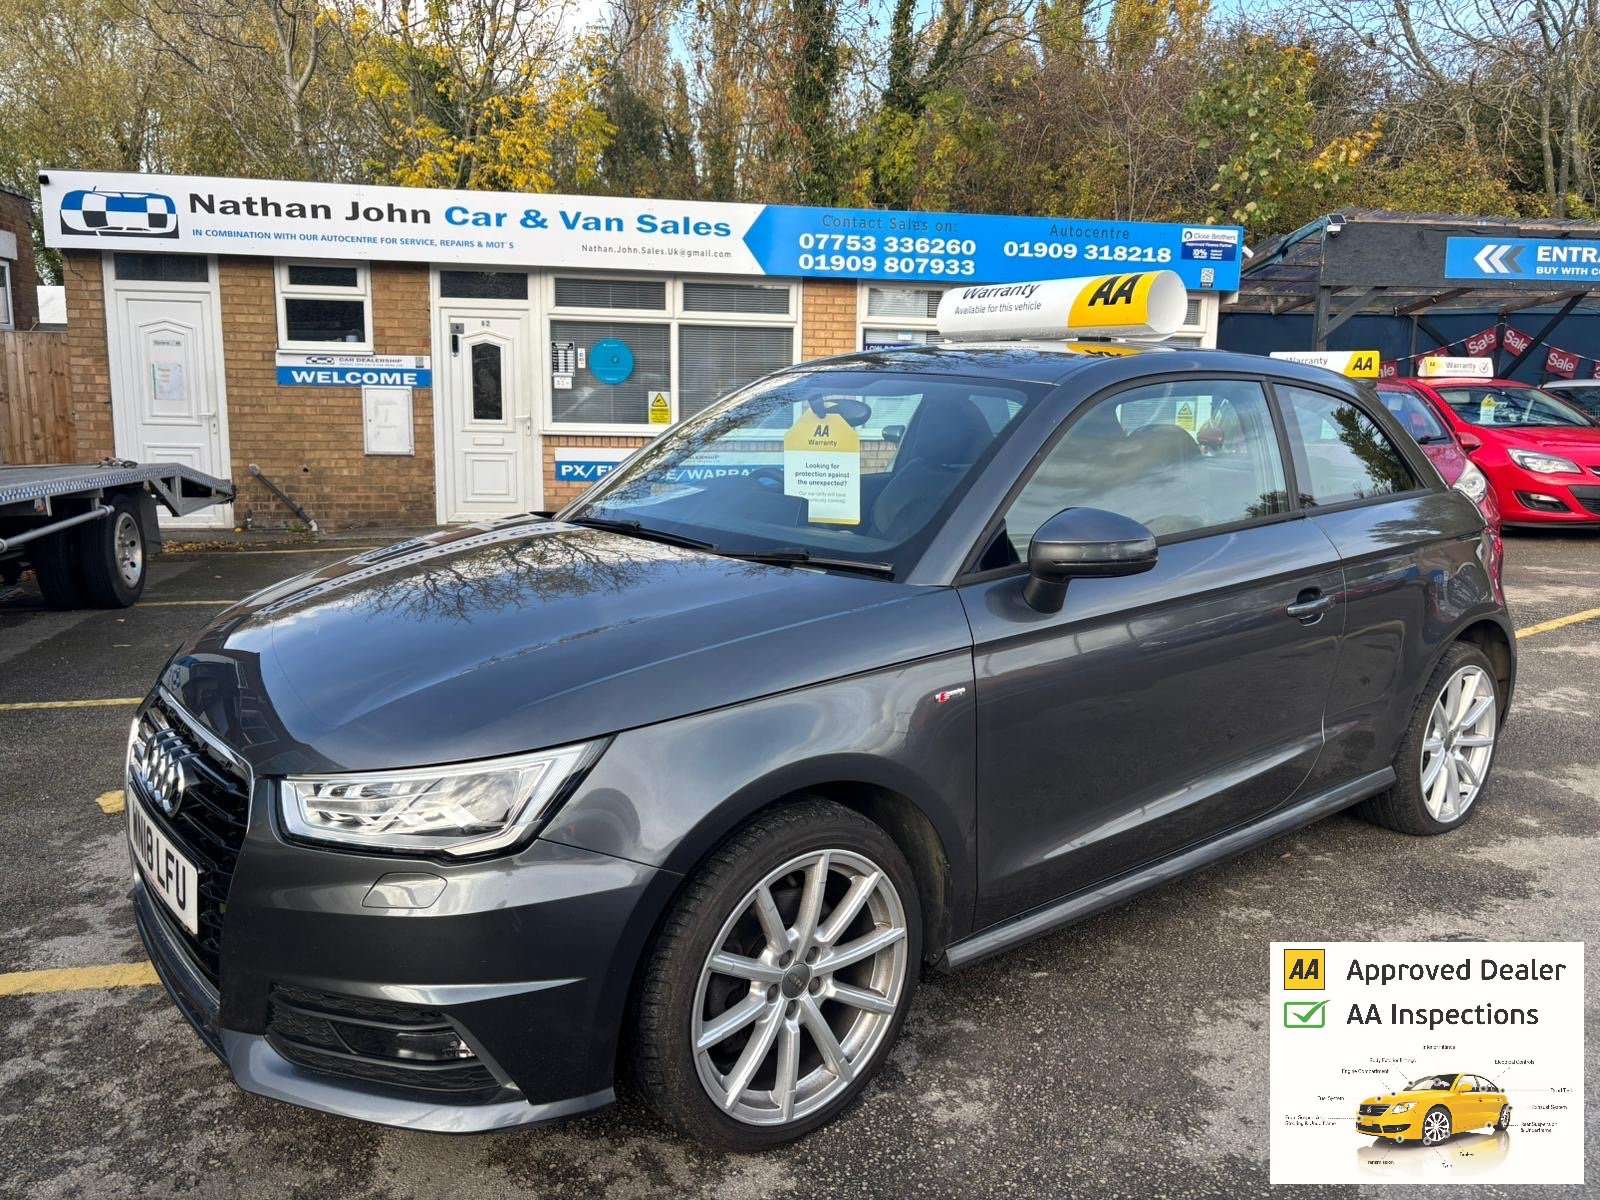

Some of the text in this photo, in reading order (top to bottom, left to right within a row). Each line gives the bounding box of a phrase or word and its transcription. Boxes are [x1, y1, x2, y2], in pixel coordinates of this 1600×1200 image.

[189, 193, 731, 237] Nathan John Car & Van Sales
[822, 214, 881, 229] Contact
[889, 217, 928, 232] Sales
[192, 228, 202, 236] IN
[205, 229, 271, 239] COMBINATION
[273, 232, 297, 240] WITH
[299, 233, 319, 241] OUR
[320, 234, 377, 244] AUTOCENTRE
[380, 237, 398, 245] FOR
[400, 237, 438, 247] SERVICE,
[440, 239, 475, 248] REPAIRS
[1050, 224, 1130, 240] Autocentre
[581, 244, 732, 258] Nathan.John.Sales.Uk@gmail.com
[799, 233, 976, 256] 07753 336260
[1003, 241, 1078, 259] 01909
[1083, 245, 1172, 263] 318218
[1537, 245, 1600, 263] ENTR
[798, 254, 976, 275] 01909 807933
[1536, 266, 1558, 275] BUY
[1561, 267, 1588, 275] WITH
[963, 274, 1144, 307] Warranty AA
[955, 300, 1042, 315] Available for this vehicle
[1468, 334, 1496, 354] Sale
[1504, 330, 1528, 352] Sale
[1285, 357, 1372, 370] Warranty AA
[1446, 362, 1476, 373] Warranty
[1548, 352, 1574, 372] Sale
[291, 370, 418, 385] WELCOME
[814, 425, 830, 437] AA
[808, 439, 837, 447] Warranty
[806, 462, 829, 470] Looking
[156, 837, 186, 911] LFU
